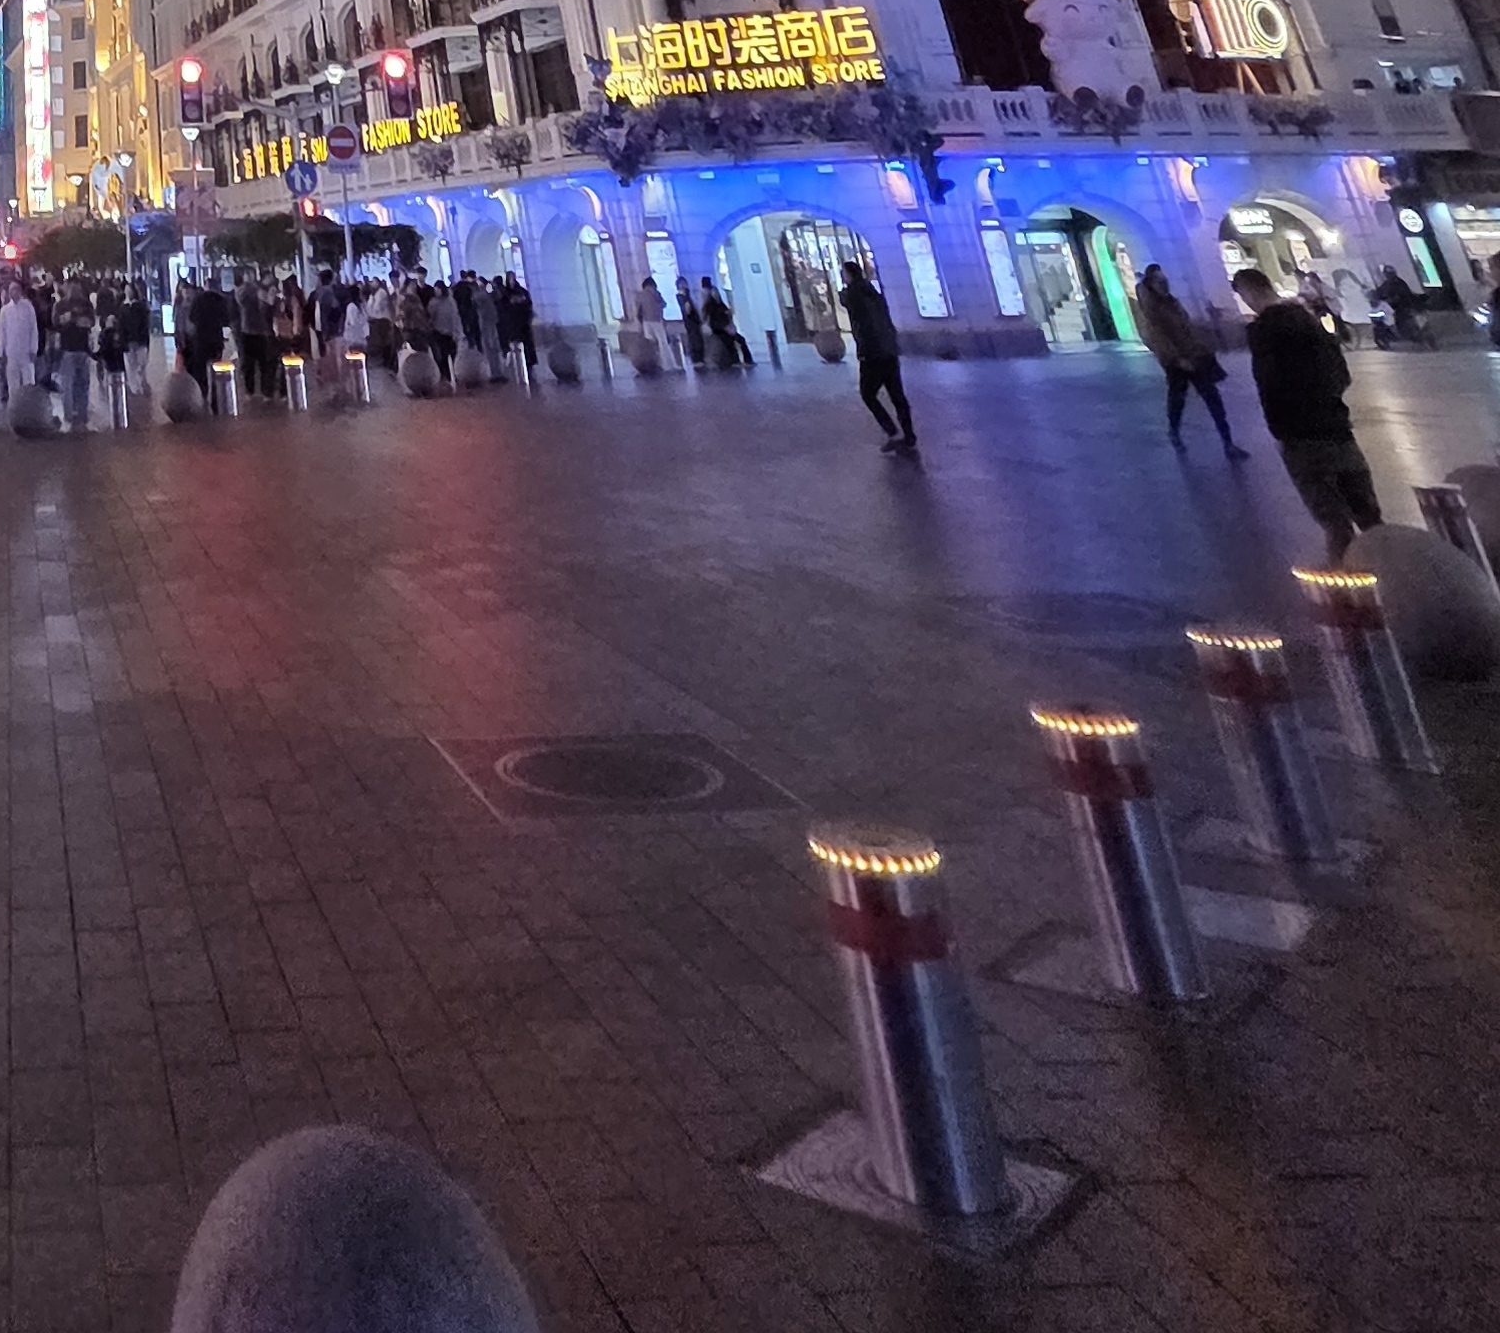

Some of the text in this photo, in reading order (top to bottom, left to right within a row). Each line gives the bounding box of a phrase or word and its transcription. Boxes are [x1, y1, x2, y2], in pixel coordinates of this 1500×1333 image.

[606, 5, 878, 74] 上海时装商店
[604, 59, 887, 101] SHANGHAI FASHION STORE
[361, 117, 412, 154] FASHION
[416, 101, 462, 139] STORE
